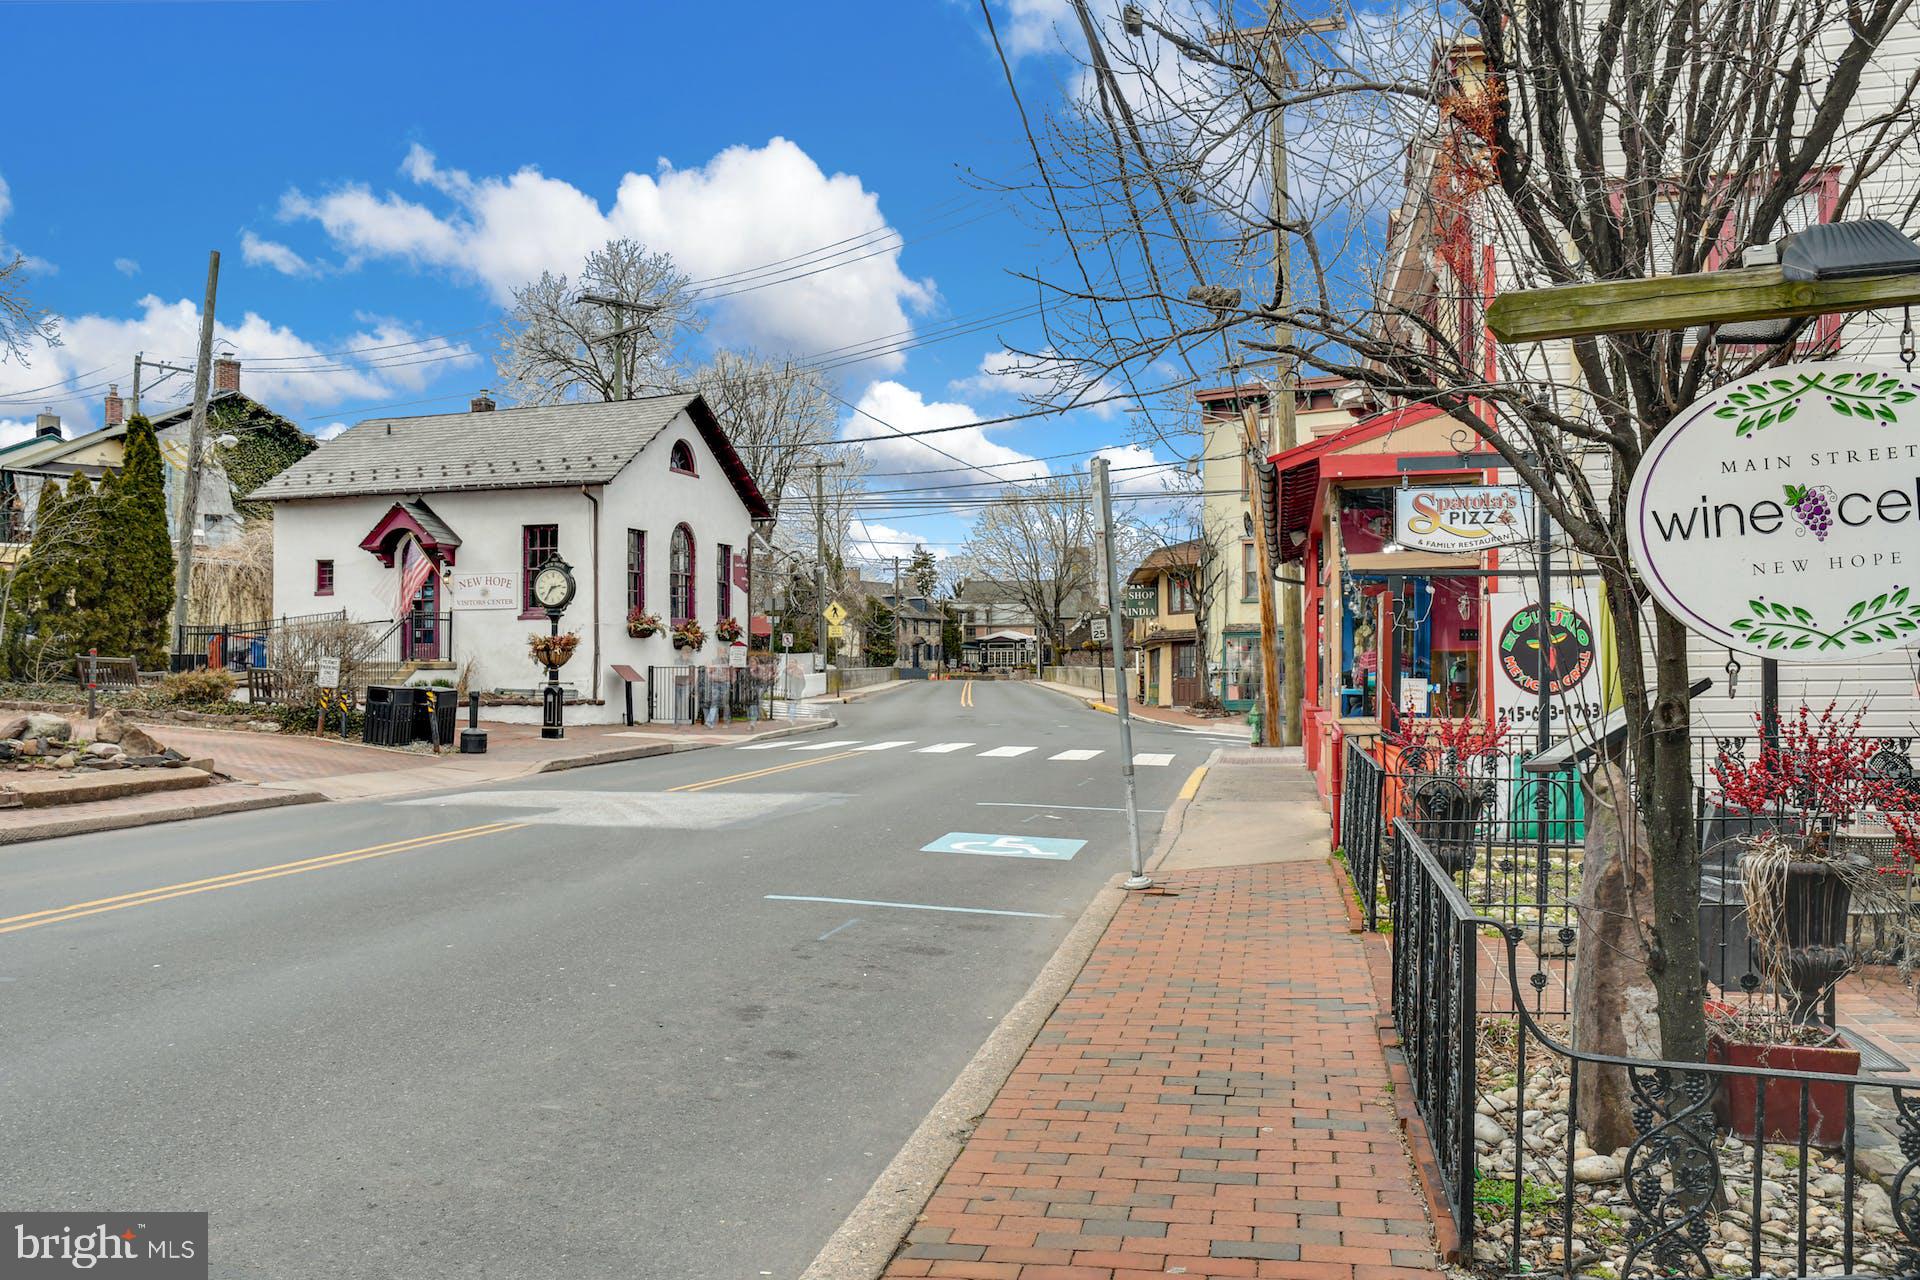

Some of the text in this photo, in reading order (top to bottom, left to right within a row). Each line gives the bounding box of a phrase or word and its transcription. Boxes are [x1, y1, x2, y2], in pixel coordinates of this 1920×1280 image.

[1721, 444, 1918, 474] MAIN STREET
[1408, 491, 1518, 538] Spatola's
[1651, 495, 1784, 542] wine
[1425, 540, 1457, 549] FAMILY
[1752, 551, 1903, 576] NEW HOPE
[458, 575, 513, 590] NEW HOPE
[1128, 591, 1155, 600] SHOP
[1128, 607, 1156, 617] INDIA
[1093, 630, 1106, 639] 25
[1504, 655, 1561, 692] MEXICN
[1498, 702, 1601, 722] 215-63-1763
